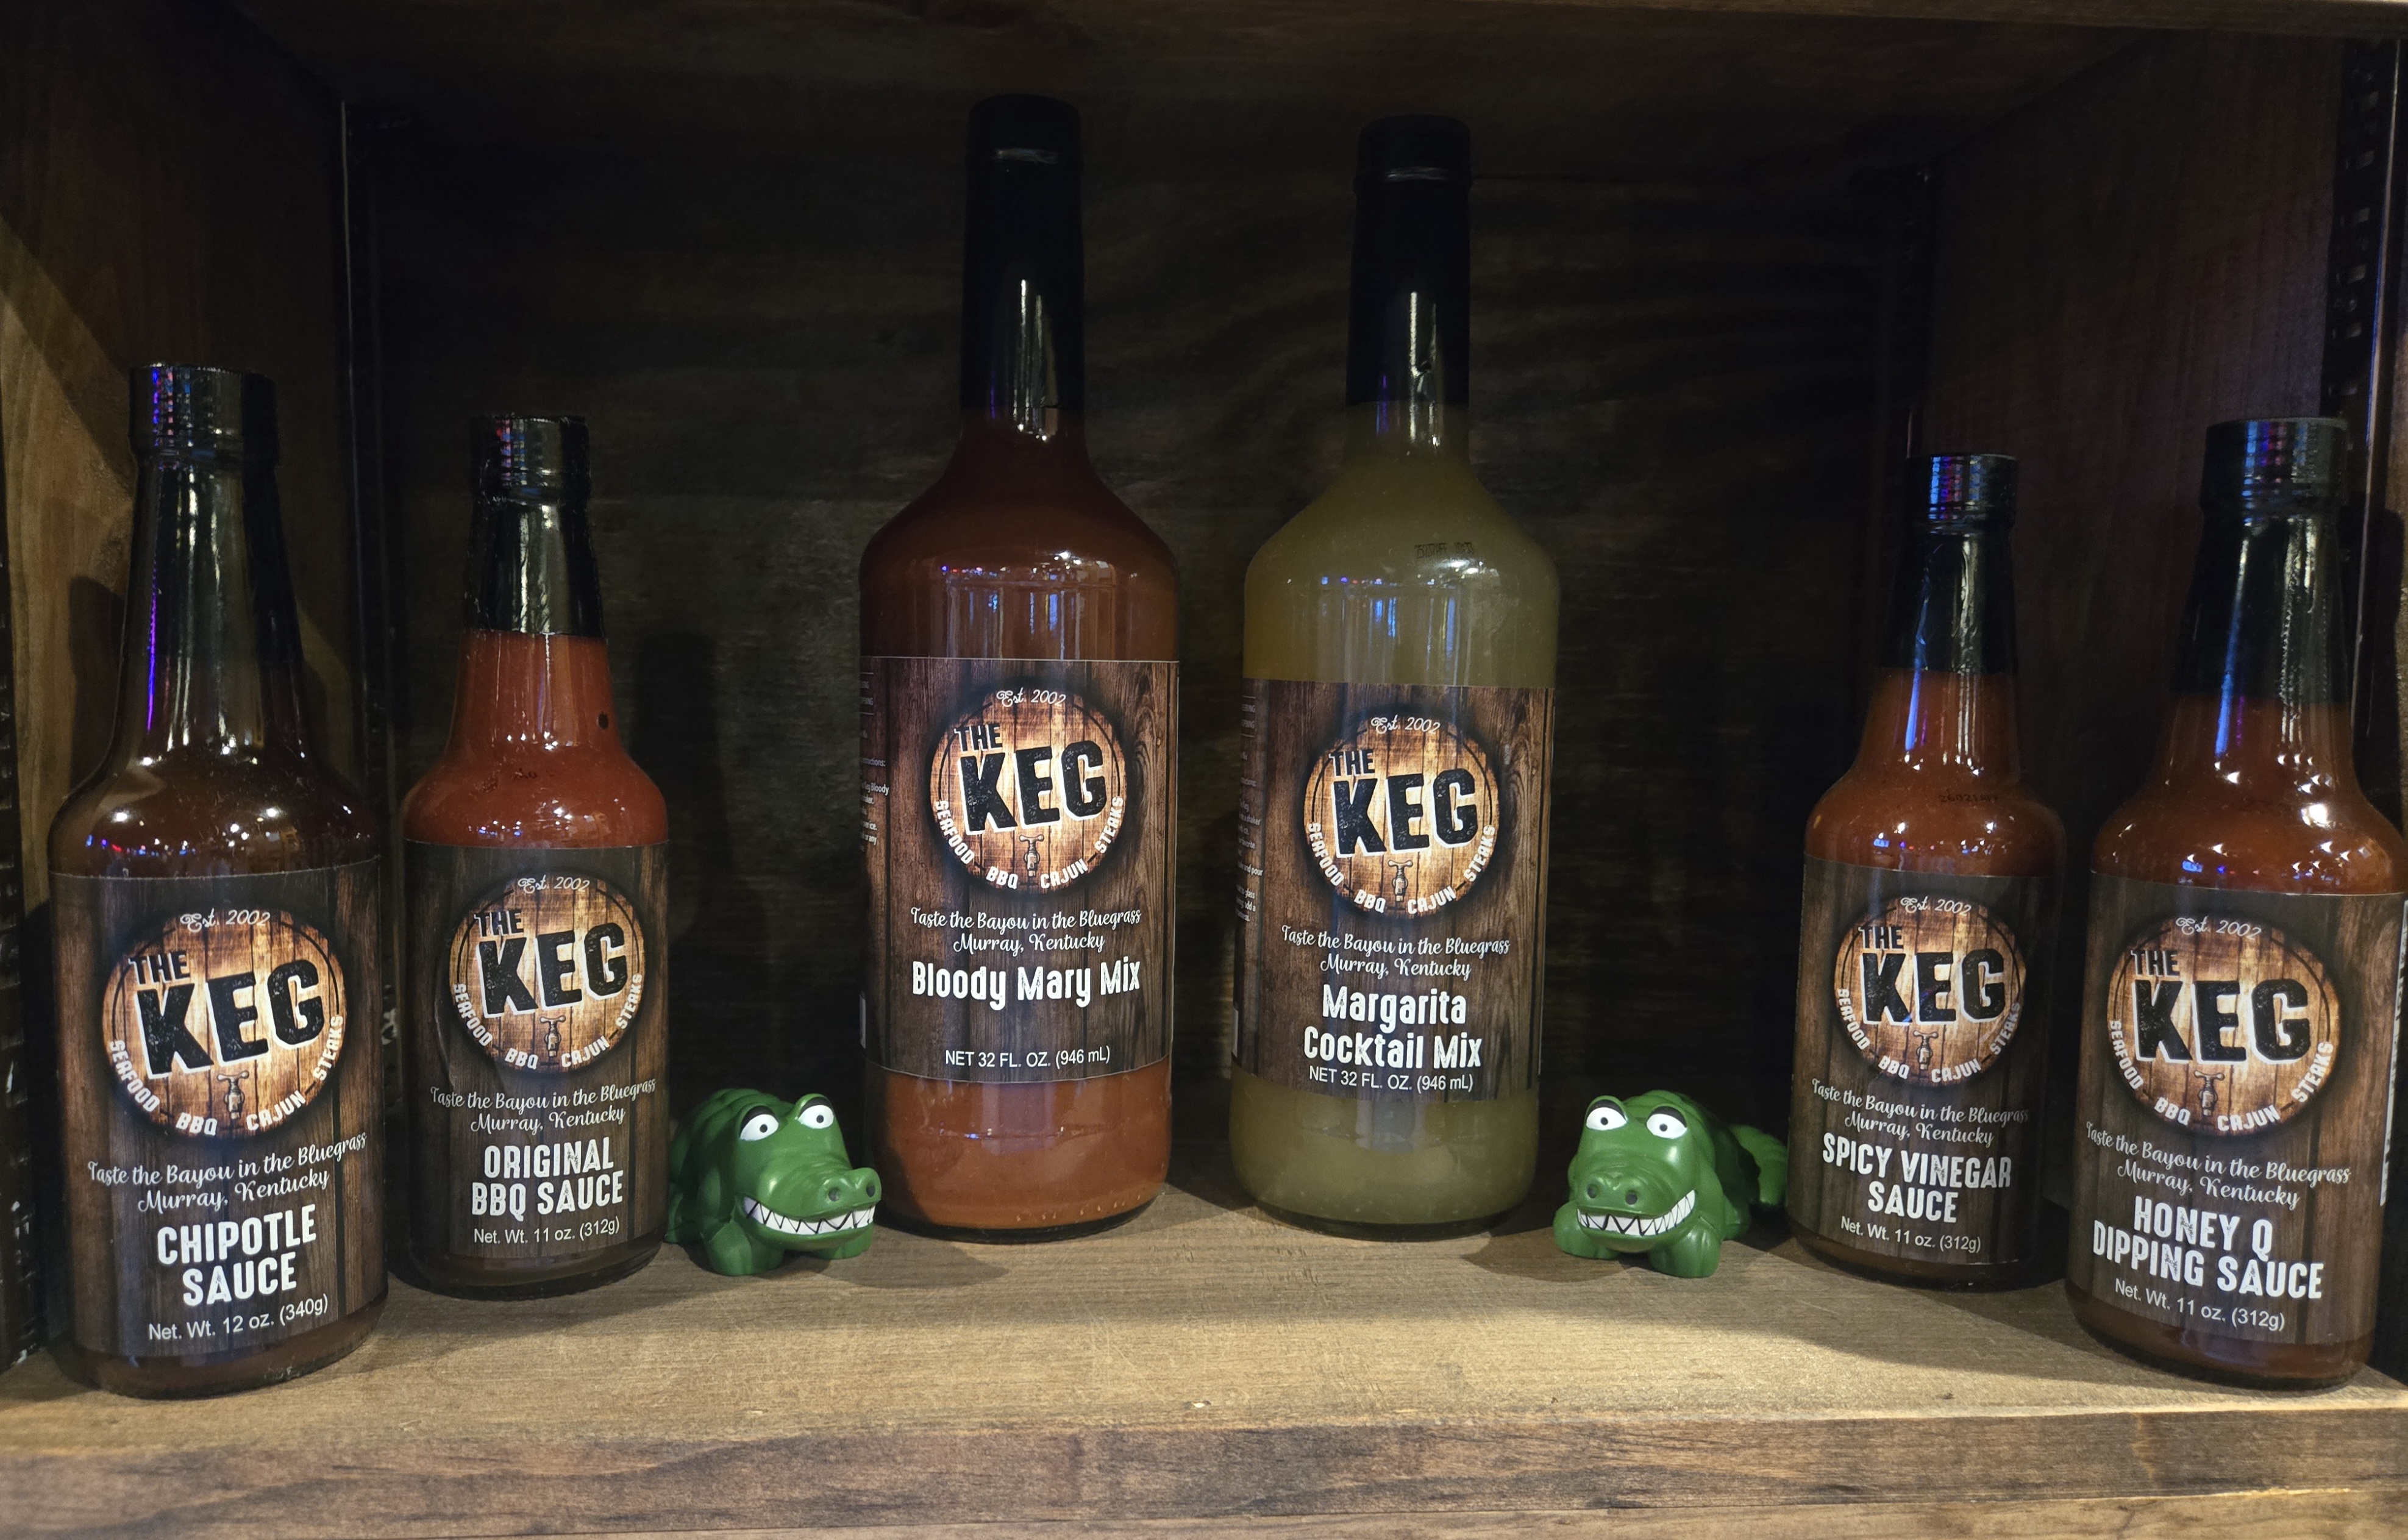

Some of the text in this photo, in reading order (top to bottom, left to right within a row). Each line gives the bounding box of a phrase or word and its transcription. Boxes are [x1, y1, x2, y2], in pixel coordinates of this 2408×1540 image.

[996, 686, 1066, 707] Est. 2002
[954, 723, 1002, 752] THE
[1370, 715, 1440, 735] Est. 2002
[1328, 749, 1376, 777] THE
[871, 782, 889, 796] Bloody
[957, 740, 1108, 835] KEG
[1331, 769, 1479, 858] KEG
[935, 796, 1124, 889] SEAFOOD BBQ CAJUN STEAKS
[517, 875, 590, 894] Est. 2002
[1251, 867, 1263, 876] pour
[1308, 822, 1495, 914] SEAFOOD BBQ CAJUN STEAKS
[179, 908, 271, 933] Est. 2002
[474, 910, 524, 937] THE
[911, 907, 1141, 935] Taste the Bayou in the Bluegrass
[1900, 896, 1971, 915] Est. 2002
[953, 930, 1105, 957] Murray, Kentucky
[1281, 925, 1510, 958] Taste the Bayou in the Bluegrass
[1858, 925, 1903, 950] THE
[2175, 916, 2262, 941] Est. 2002
[128, 949, 190, 986] THE
[476, 922, 627, 1019] KEG
[913, 956, 1139, 1011] Bloody Mary Mix
[1320, 954, 1471, 980] Murray, Kentucky
[2131, 949, 2179, 978] THE
[1323, 984, 1466, 1033] Margarita
[1859, 948, 2005, 1025] KEG
[135, 958, 325, 1080] KEG
[454, 974, 642, 1069] SEAFOOD BBQ CAJUN STEAKS
[1839, 989, 2021, 1083] SEAFOOD BBQ CAJUN STEAKS
[2131, 978, 2310, 1065] KEG
[945, 1046, 1110, 1069] NET 32 FL. OZ. (946 mL)
[1304, 1026, 1481, 1069] Cocktail Mix
[110, 1013, 344, 1136] SEAFOOD BBQ CAJUN STEAKS
[430, 1077, 656, 1113] Taste the Bayou in the Bluegrass
[1309, 1065, 1473, 1093] NET 32 FL. OZ. (946 mL)
[2109, 1019, 2334, 1132] SEAFOOD BBQ CAJUN STEAKS
[470, 1105, 626, 1135] Murray, Kentucky
[1812, 1078, 2029, 1127] Taste the Bayou in the Bluegrass
[1844, 1111, 1993, 1149] Murray, Kentucky
[87, 1132, 366, 1191] Taste the Bayou in the Bluegrass
[484, 1136, 614, 1178] ORIGINAL
[1822, 1132, 2012, 1189] SPICY VINEGAR
[2086, 1120, 2351, 1187] Taste the Bayou in the Bluegrass
[137, 1169, 330, 1214] Murray, Kentucky
[472, 1171, 624, 1221] BBQ SAUCE
[1867, 1180, 1958, 1224] SAUCE
[2117, 1160, 2299, 1211] Murray, Kentucky
[157, 1203, 317, 1266] CHIPOTLE
[474, 1217, 619, 1244] Net. Wt. 11 oz. (312g)
[1841, 1216, 1981, 1253] Net. Wt. 11 oz. (312g)
[2134, 1195, 2273, 1262] HONEY Q
[182, 1252, 297, 1307] SAUCE
[2092, 1219, 2324, 1300] DIPPING SAUCE
[148, 1294, 328, 1341] Net. Wt. 12 oz. (340g)
[2115, 1278, 2285, 1332] Net. Wt. 11 oz. (312g)
